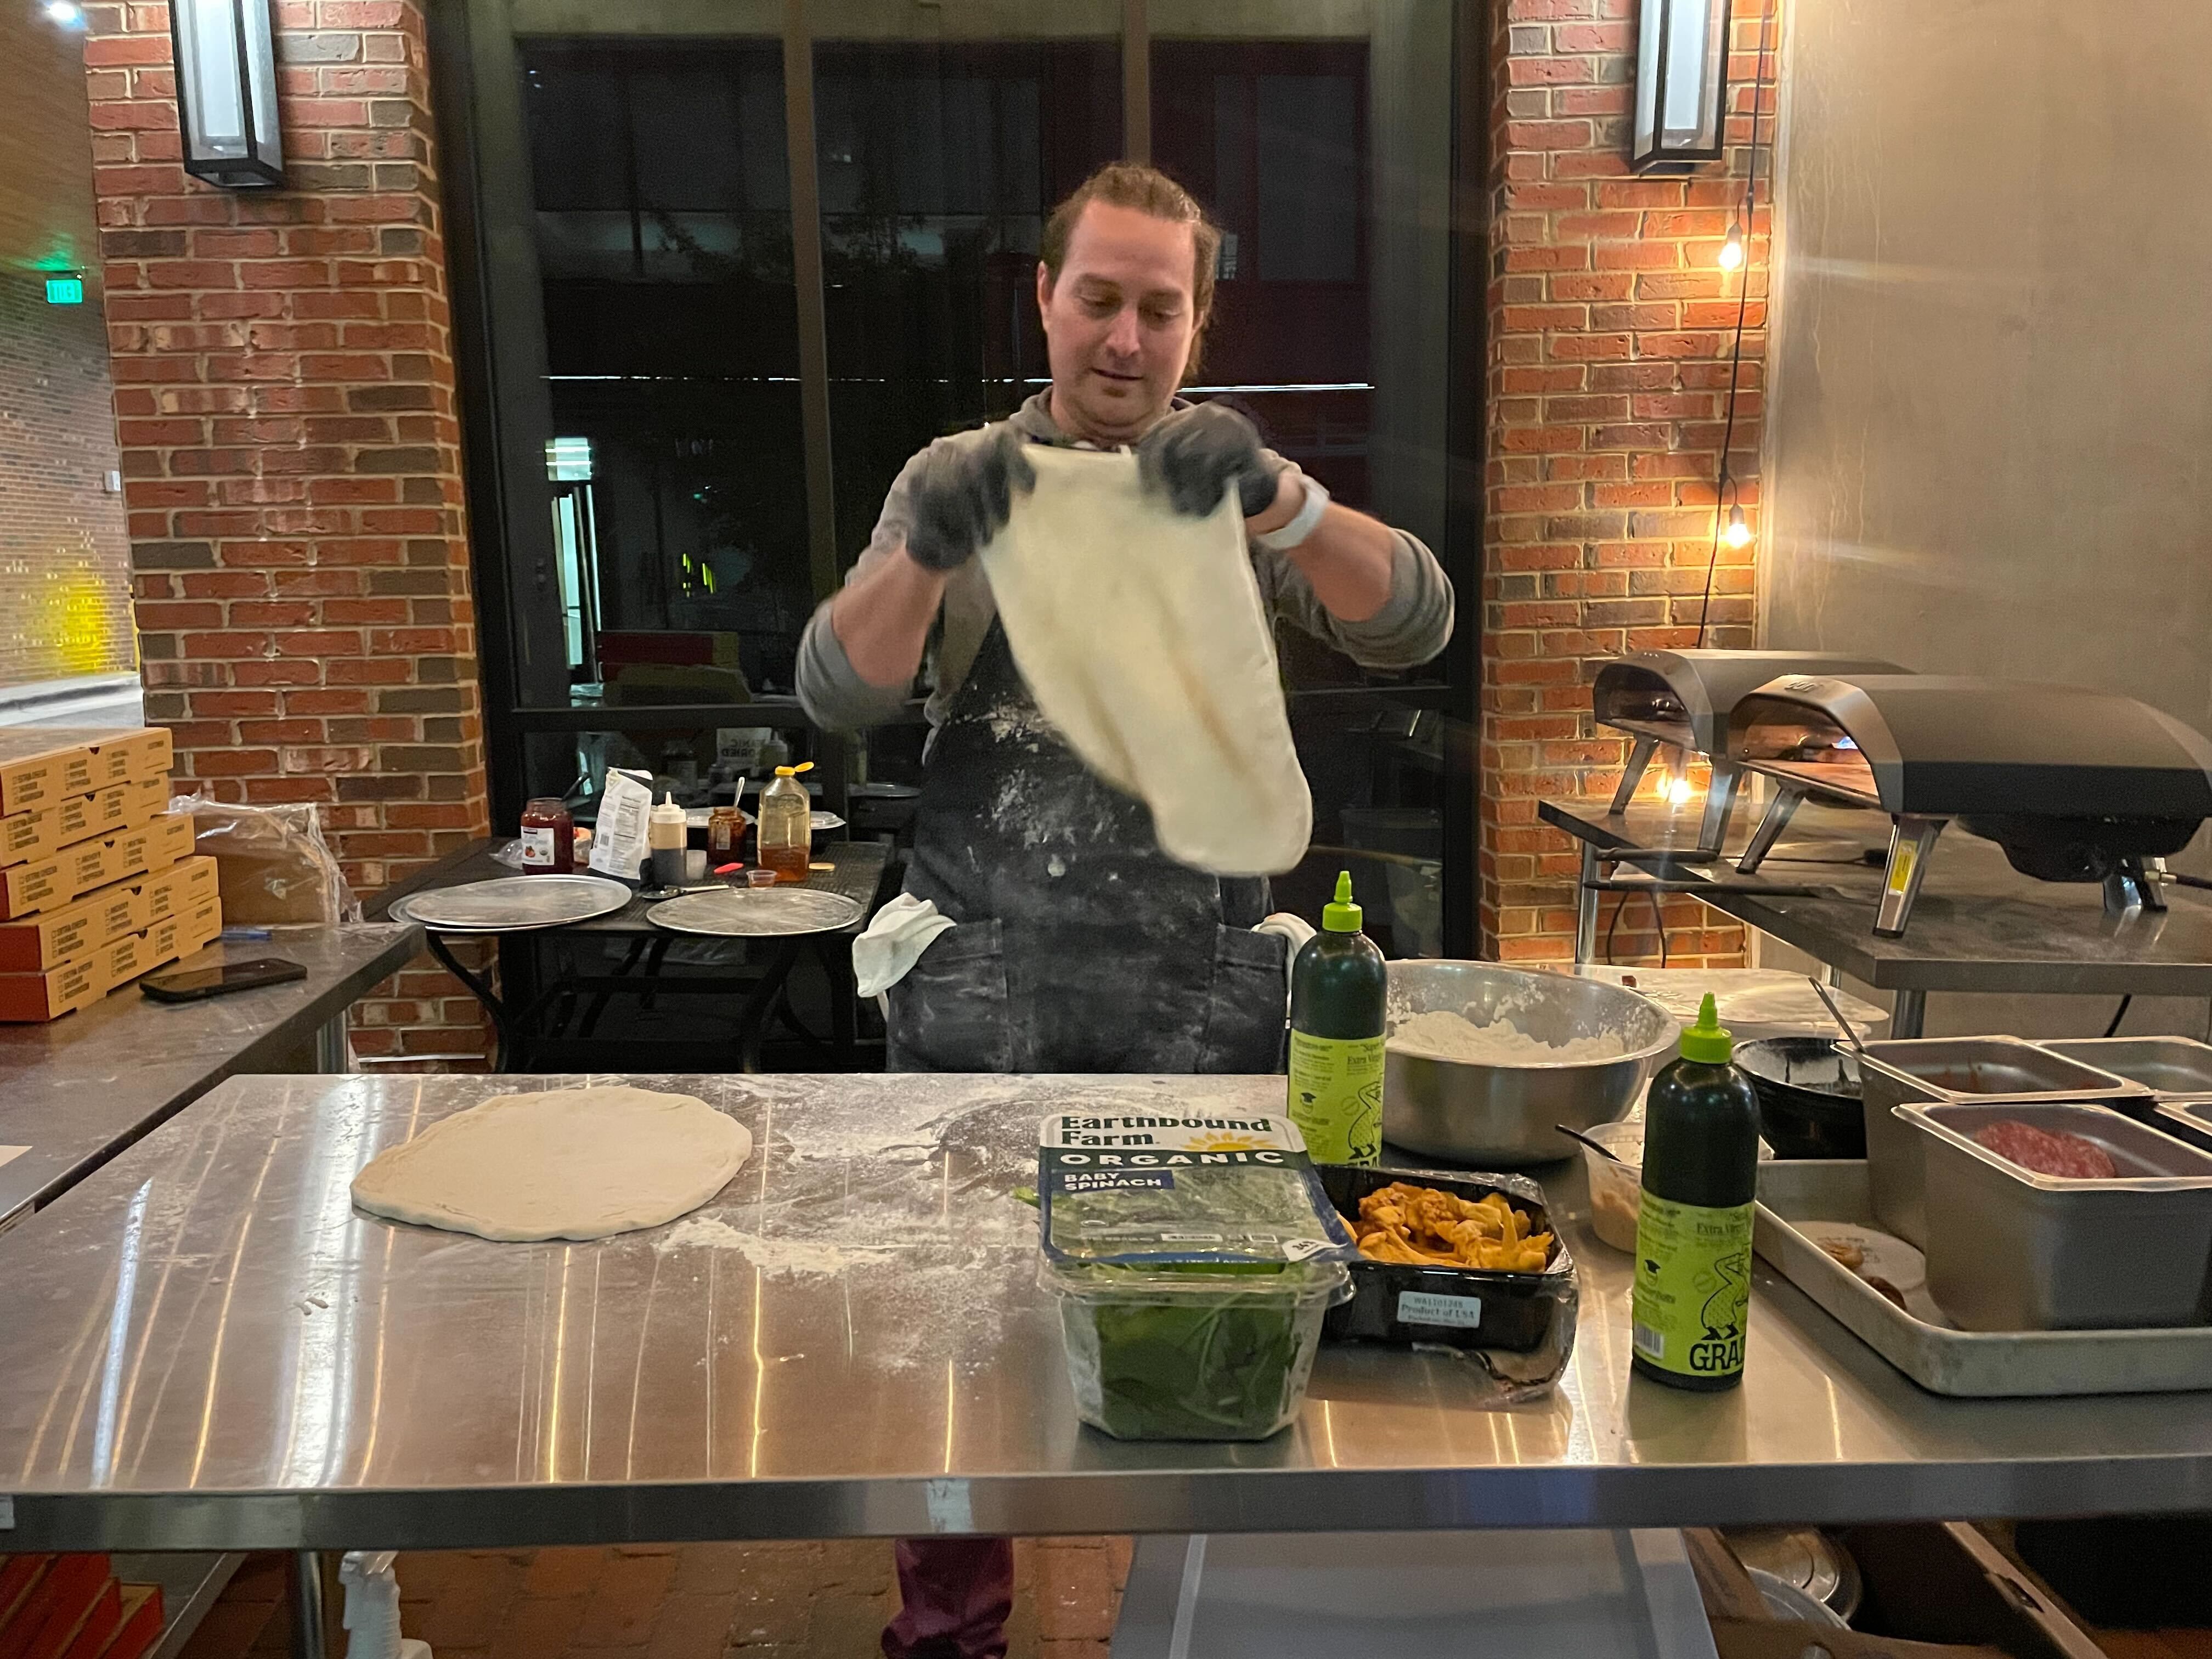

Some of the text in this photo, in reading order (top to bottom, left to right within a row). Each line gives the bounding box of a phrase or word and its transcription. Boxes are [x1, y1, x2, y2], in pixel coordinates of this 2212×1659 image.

[1061, 1116, 1273, 1132] Earthbound
[1061, 1131, 1154, 1146] Farm
[1060, 1152, 1284, 1166] ORGANIC
[1064, 1172, 1119, 1183] BABY
[1064, 1177, 1161, 1191] SPINACH
[1401, 1304, 1440, 1316] Product
